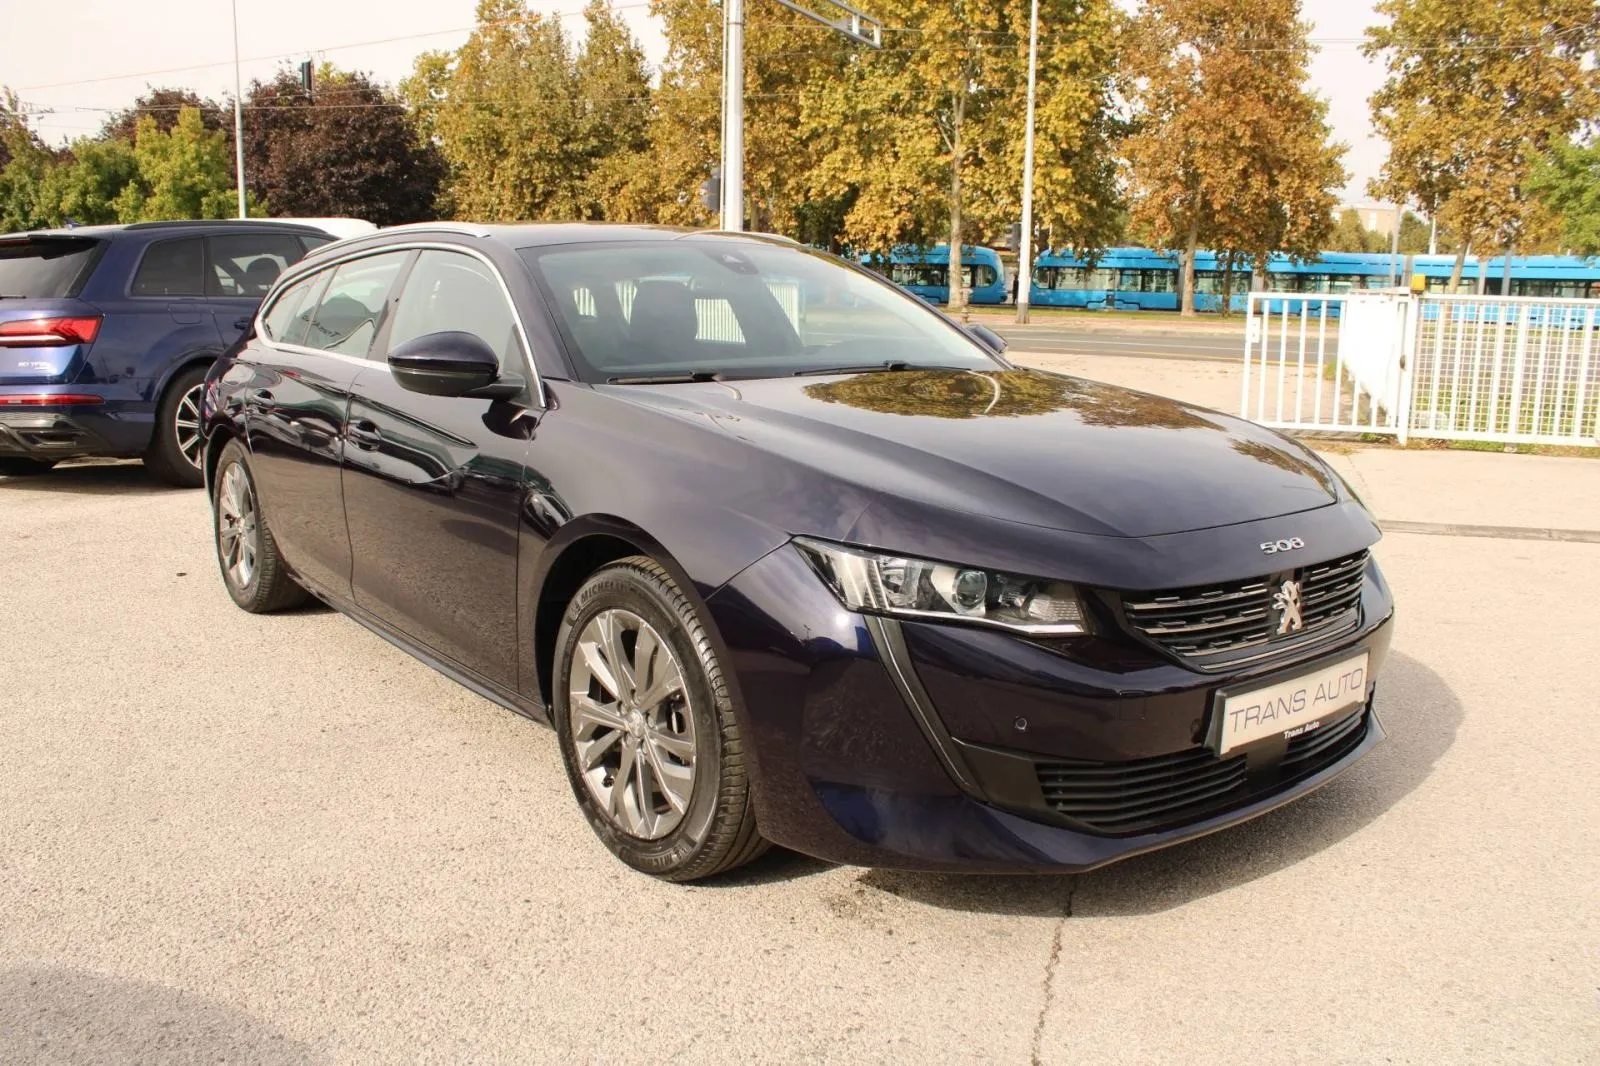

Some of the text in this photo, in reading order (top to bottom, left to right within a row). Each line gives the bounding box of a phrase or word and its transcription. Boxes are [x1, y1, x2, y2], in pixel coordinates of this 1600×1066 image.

[1260, 537, 1305, 554] 508
[1229, 668, 1363, 732] TRANS AUTO
[1284, 721, 1320, 740] Trans Auto
